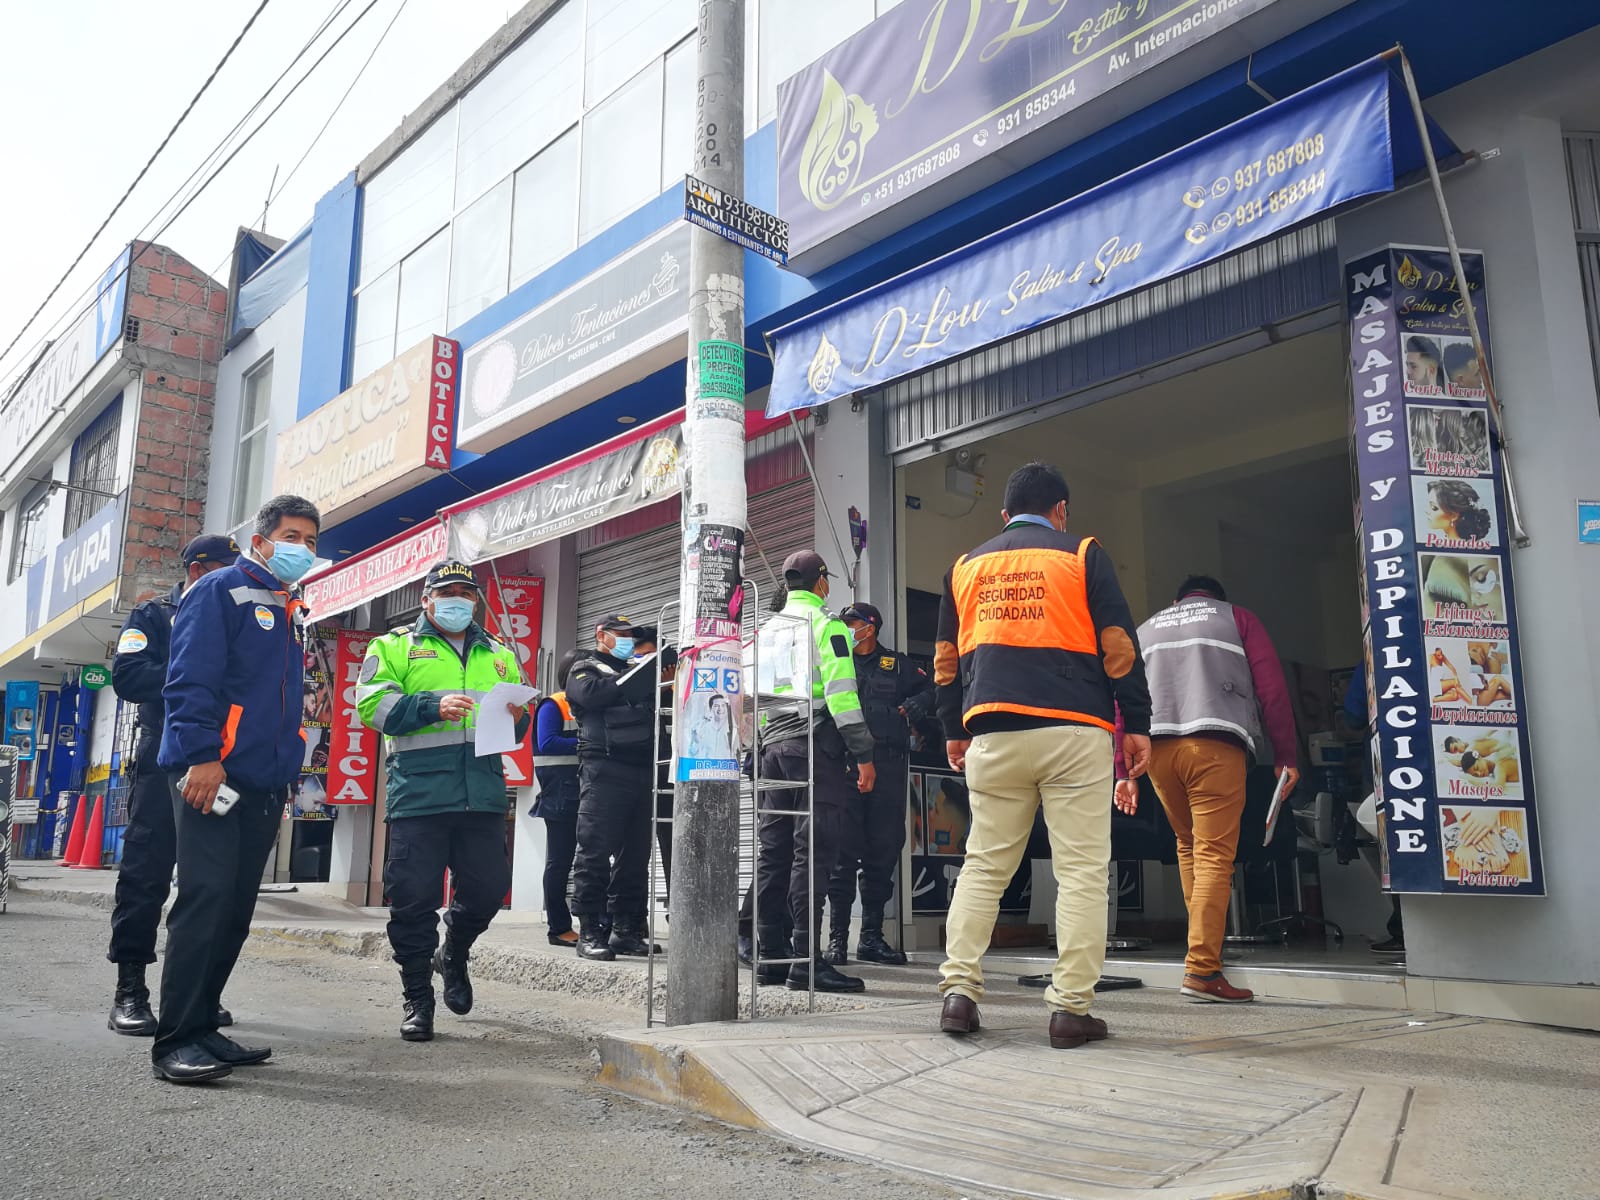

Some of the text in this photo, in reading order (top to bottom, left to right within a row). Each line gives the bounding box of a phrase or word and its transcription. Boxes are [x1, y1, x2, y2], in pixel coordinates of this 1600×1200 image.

[1068, 5, 1132, 55] Estilo
[874, 0, 1243, 200] +51 937687808 931 858344 Av. Internaciona
[1235, 133, 1325, 191] 937 687808
[687, 177, 789, 239] CYM 931981938
[1236, 169, 1327, 227] 931 858344
[687, 195, 789, 253] ARQUITECTOS
[727, 230, 764, 255] ESTUDIANTES
[567, 283, 653, 345] Tentaciones
[851, 286, 990, 377] D'Lou
[1093, 236, 1144, 283] Spa
[1352, 263, 1394, 453] MASAJES
[430, 339, 453, 465] BOTICA
[1403, 380, 1442, 396] Corte
[290, 361, 410, 469] BOTICA
[1423, 447, 1479, 468] Tintes y
[1424, 461, 1480, 477] Mechas
[489, 465, 634, 538] Dulces Tentaciones
[63, 522, 112, 592] YURA
[321, 566, 360, 602] BOTICA
[366, 526, 448, 583] BRIHAFARMA
[1425, 532, 1492, 550] Peinados
[438, 564, 473, 580] POLICIA
[978, 571, 1046, 586] SUB GERENCIA
[978, 586, 1046, 605] SEGURIDAD
[978, 606, 1045, 622] CIUDADANA
[1423, 618, 1510, 639] Extensiones
[1435, 601, 1496, 626] Lifting y
[1369, 528, 1428, 853] DEPILACIONE
[1430, 704, 1519, 726] Depilaciones
[1448, 779, 1504, 801] Masajes
[1458, 868, 1520, 887] Pedicure
